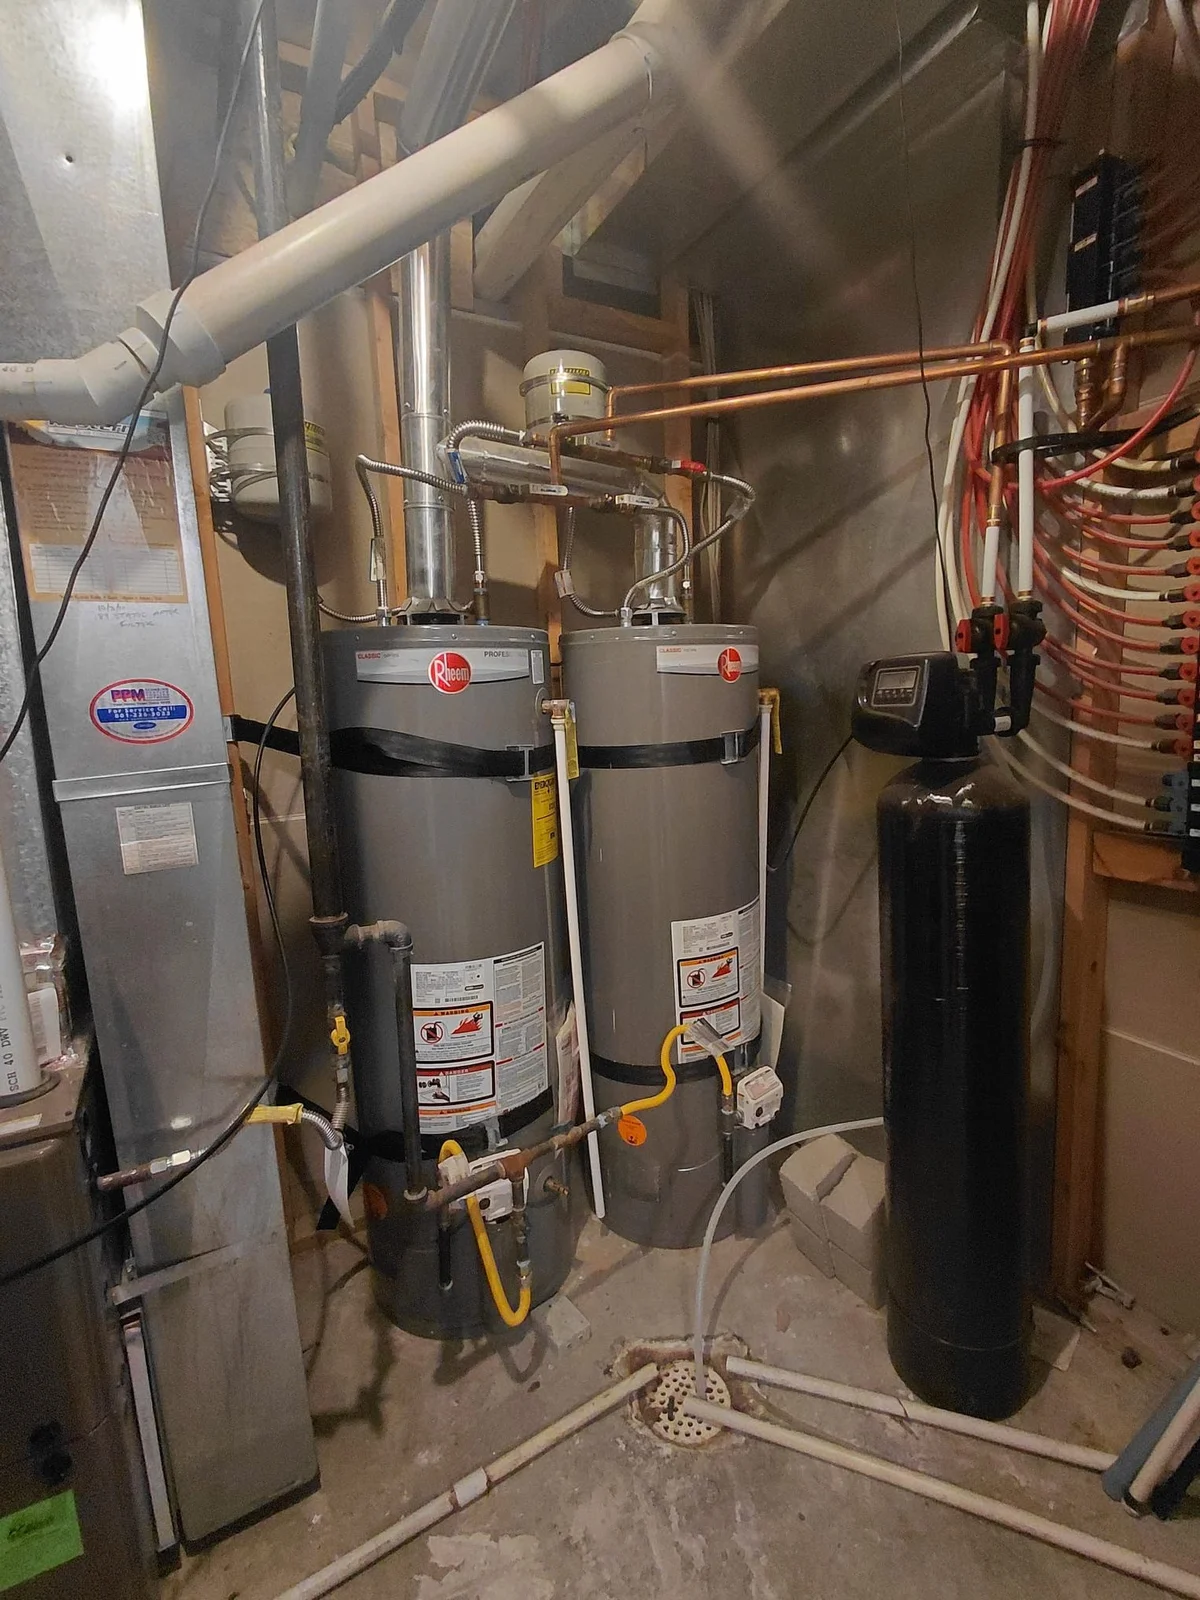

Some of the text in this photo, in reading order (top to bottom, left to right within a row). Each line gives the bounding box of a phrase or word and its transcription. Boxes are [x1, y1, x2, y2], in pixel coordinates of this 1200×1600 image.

[357, 652, 381, 660] CLASSIC
[434, 652, 470, 687] Rheem
[110, 688, 146, 703] PPM
[124, 706, 155, 714] Service
[3, 1053, 14, 1066] 40
[7, 1071, 20, 1092] SCH
